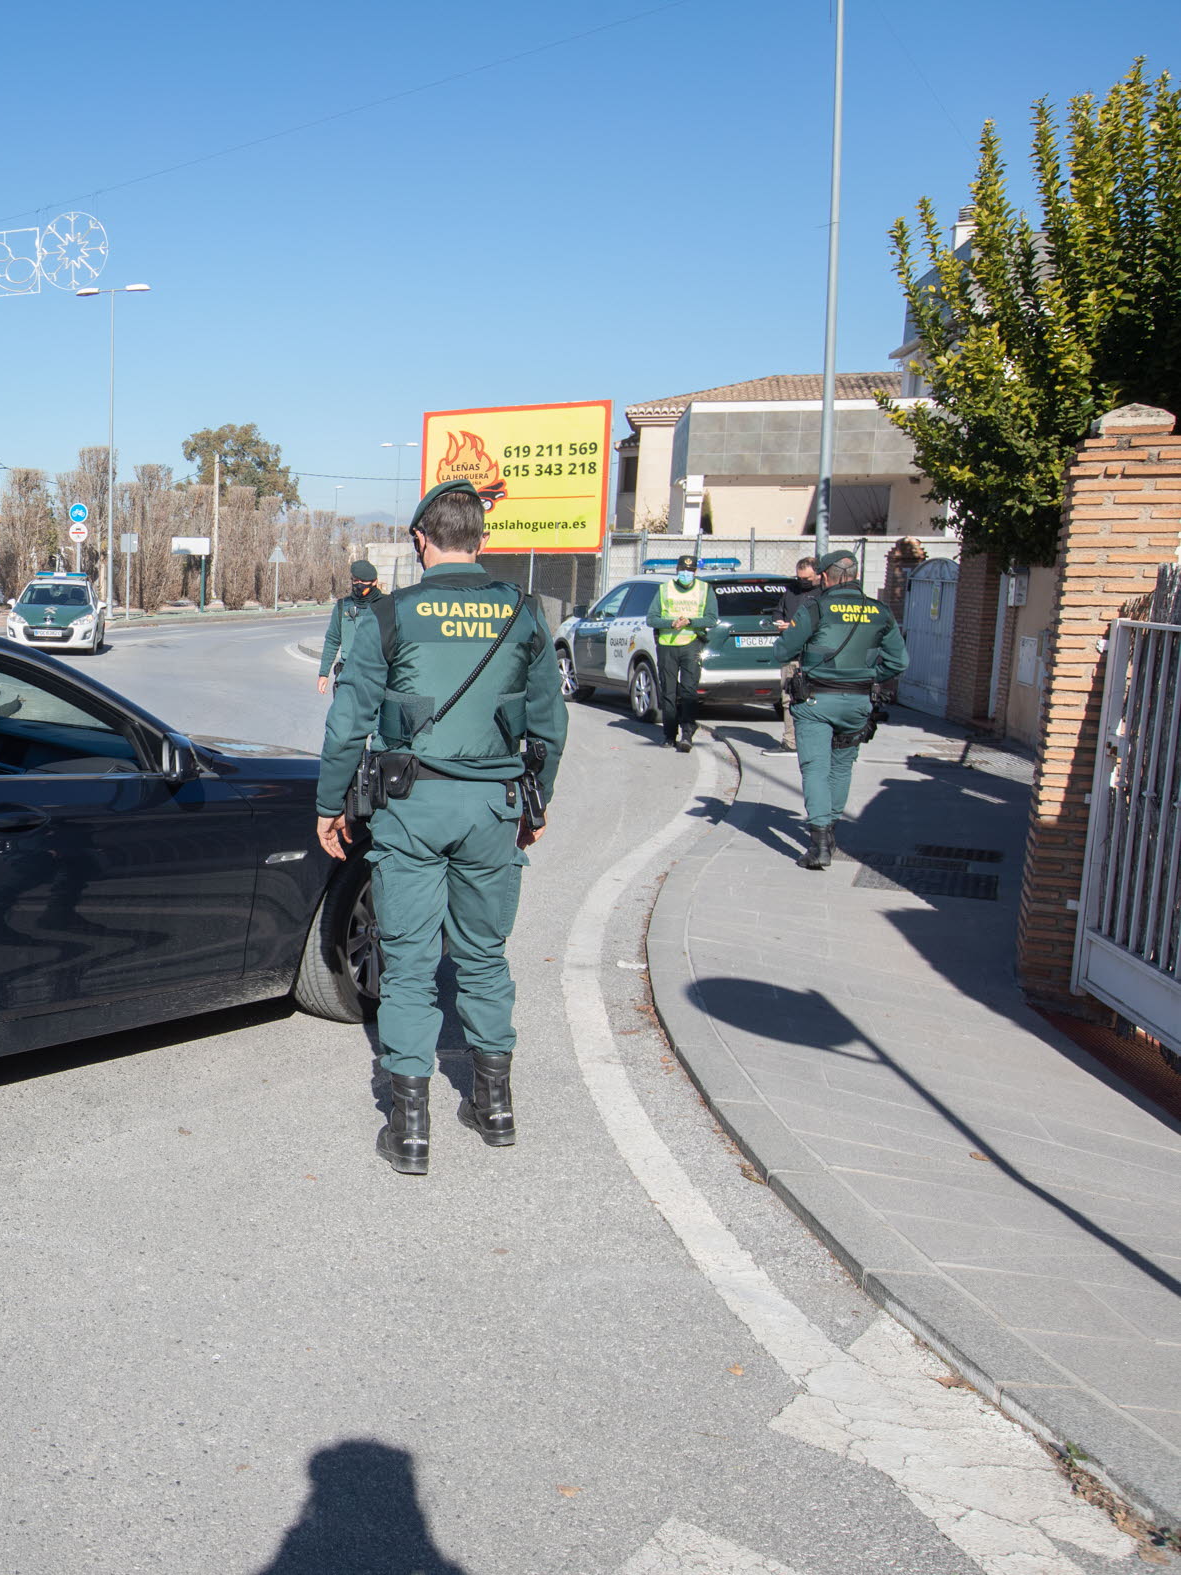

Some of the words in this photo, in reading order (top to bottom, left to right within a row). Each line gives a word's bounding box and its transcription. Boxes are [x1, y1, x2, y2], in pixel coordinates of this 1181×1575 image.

[504, 446, 530, 458] 619
[535, 444, 562, 457] 211
[570, 442, 597, 455] 569
[451, 462, 480, 472] LEÑAS
[503, 465, 529, 477] 615
[535, 464, 562, 476] 343
[568, 462, 596, 475] 218
[484, 520, 586, 532] naslahoguera.es
[715, 585, 763, 595] GUARDIA
[416, 602, 515, 619] GUARDIA
[830, 604, 880, 614] GUARDIA
[842, 613, 871, 623] CIVIL
[441, 621, 499, 639] CIVIL
[610, 638, 628, 646] GUARDIA
[741, 637, 757, 646] PGC
[758, 637, 775, 646] 874
[614, 649, 624, 658] CIVIL
